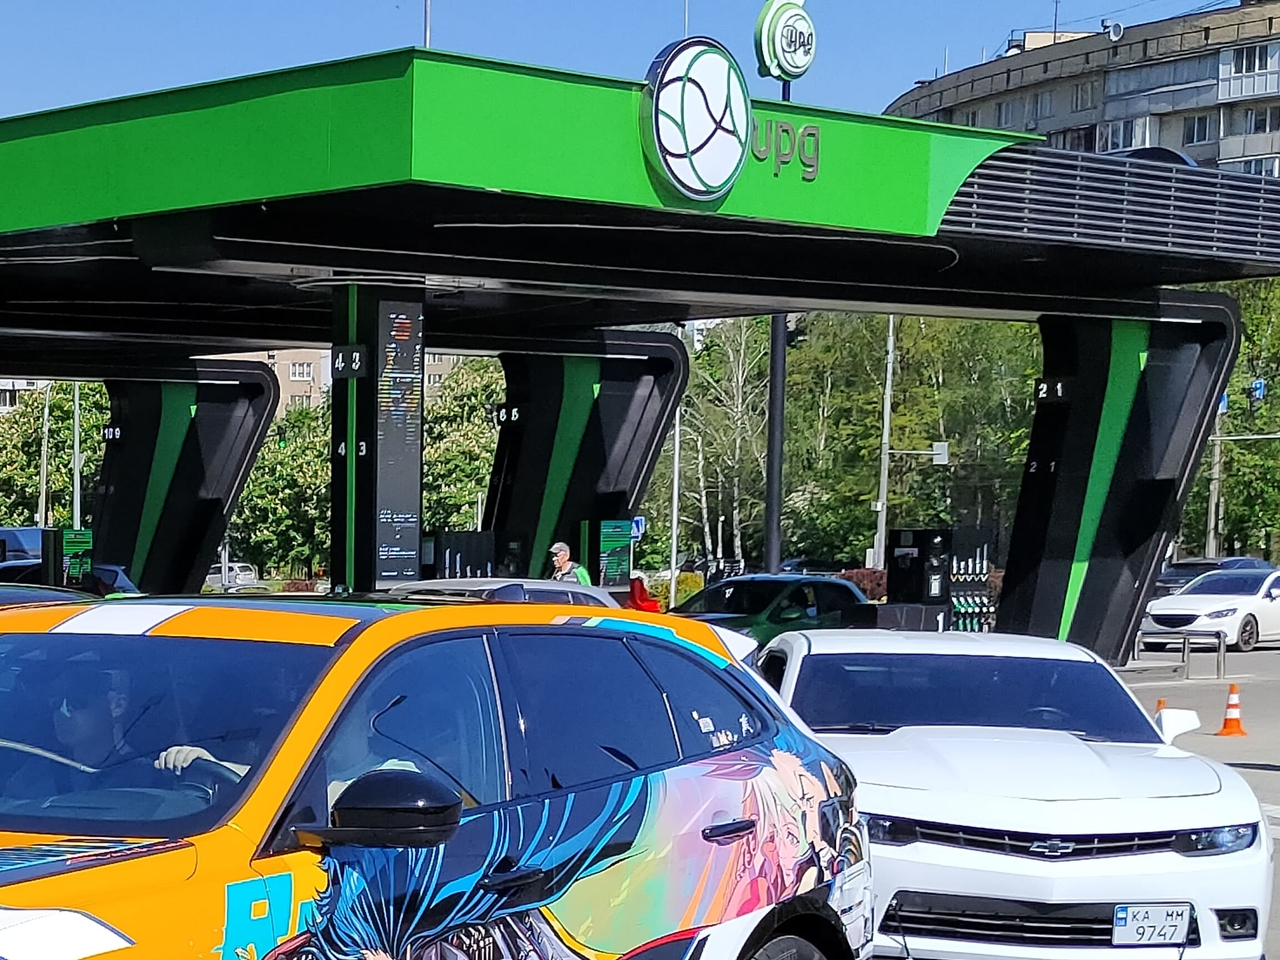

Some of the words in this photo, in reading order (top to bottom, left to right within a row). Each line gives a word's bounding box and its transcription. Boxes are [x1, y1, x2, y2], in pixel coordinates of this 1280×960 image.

[752, 118, 820, 181] upg
[1038, 383, 1048, 398] 2
[1056, 382, 1063, 397] 1
[338, 442, 346, 456] 4
[359, 441, 366, 456] 3
[1029, 461, 1038, 473] 2
[1050, 461, 1056, 473] 1
[1131, 910, 1151, 922] KA
[1135, 925, 1179, 942] 9747
